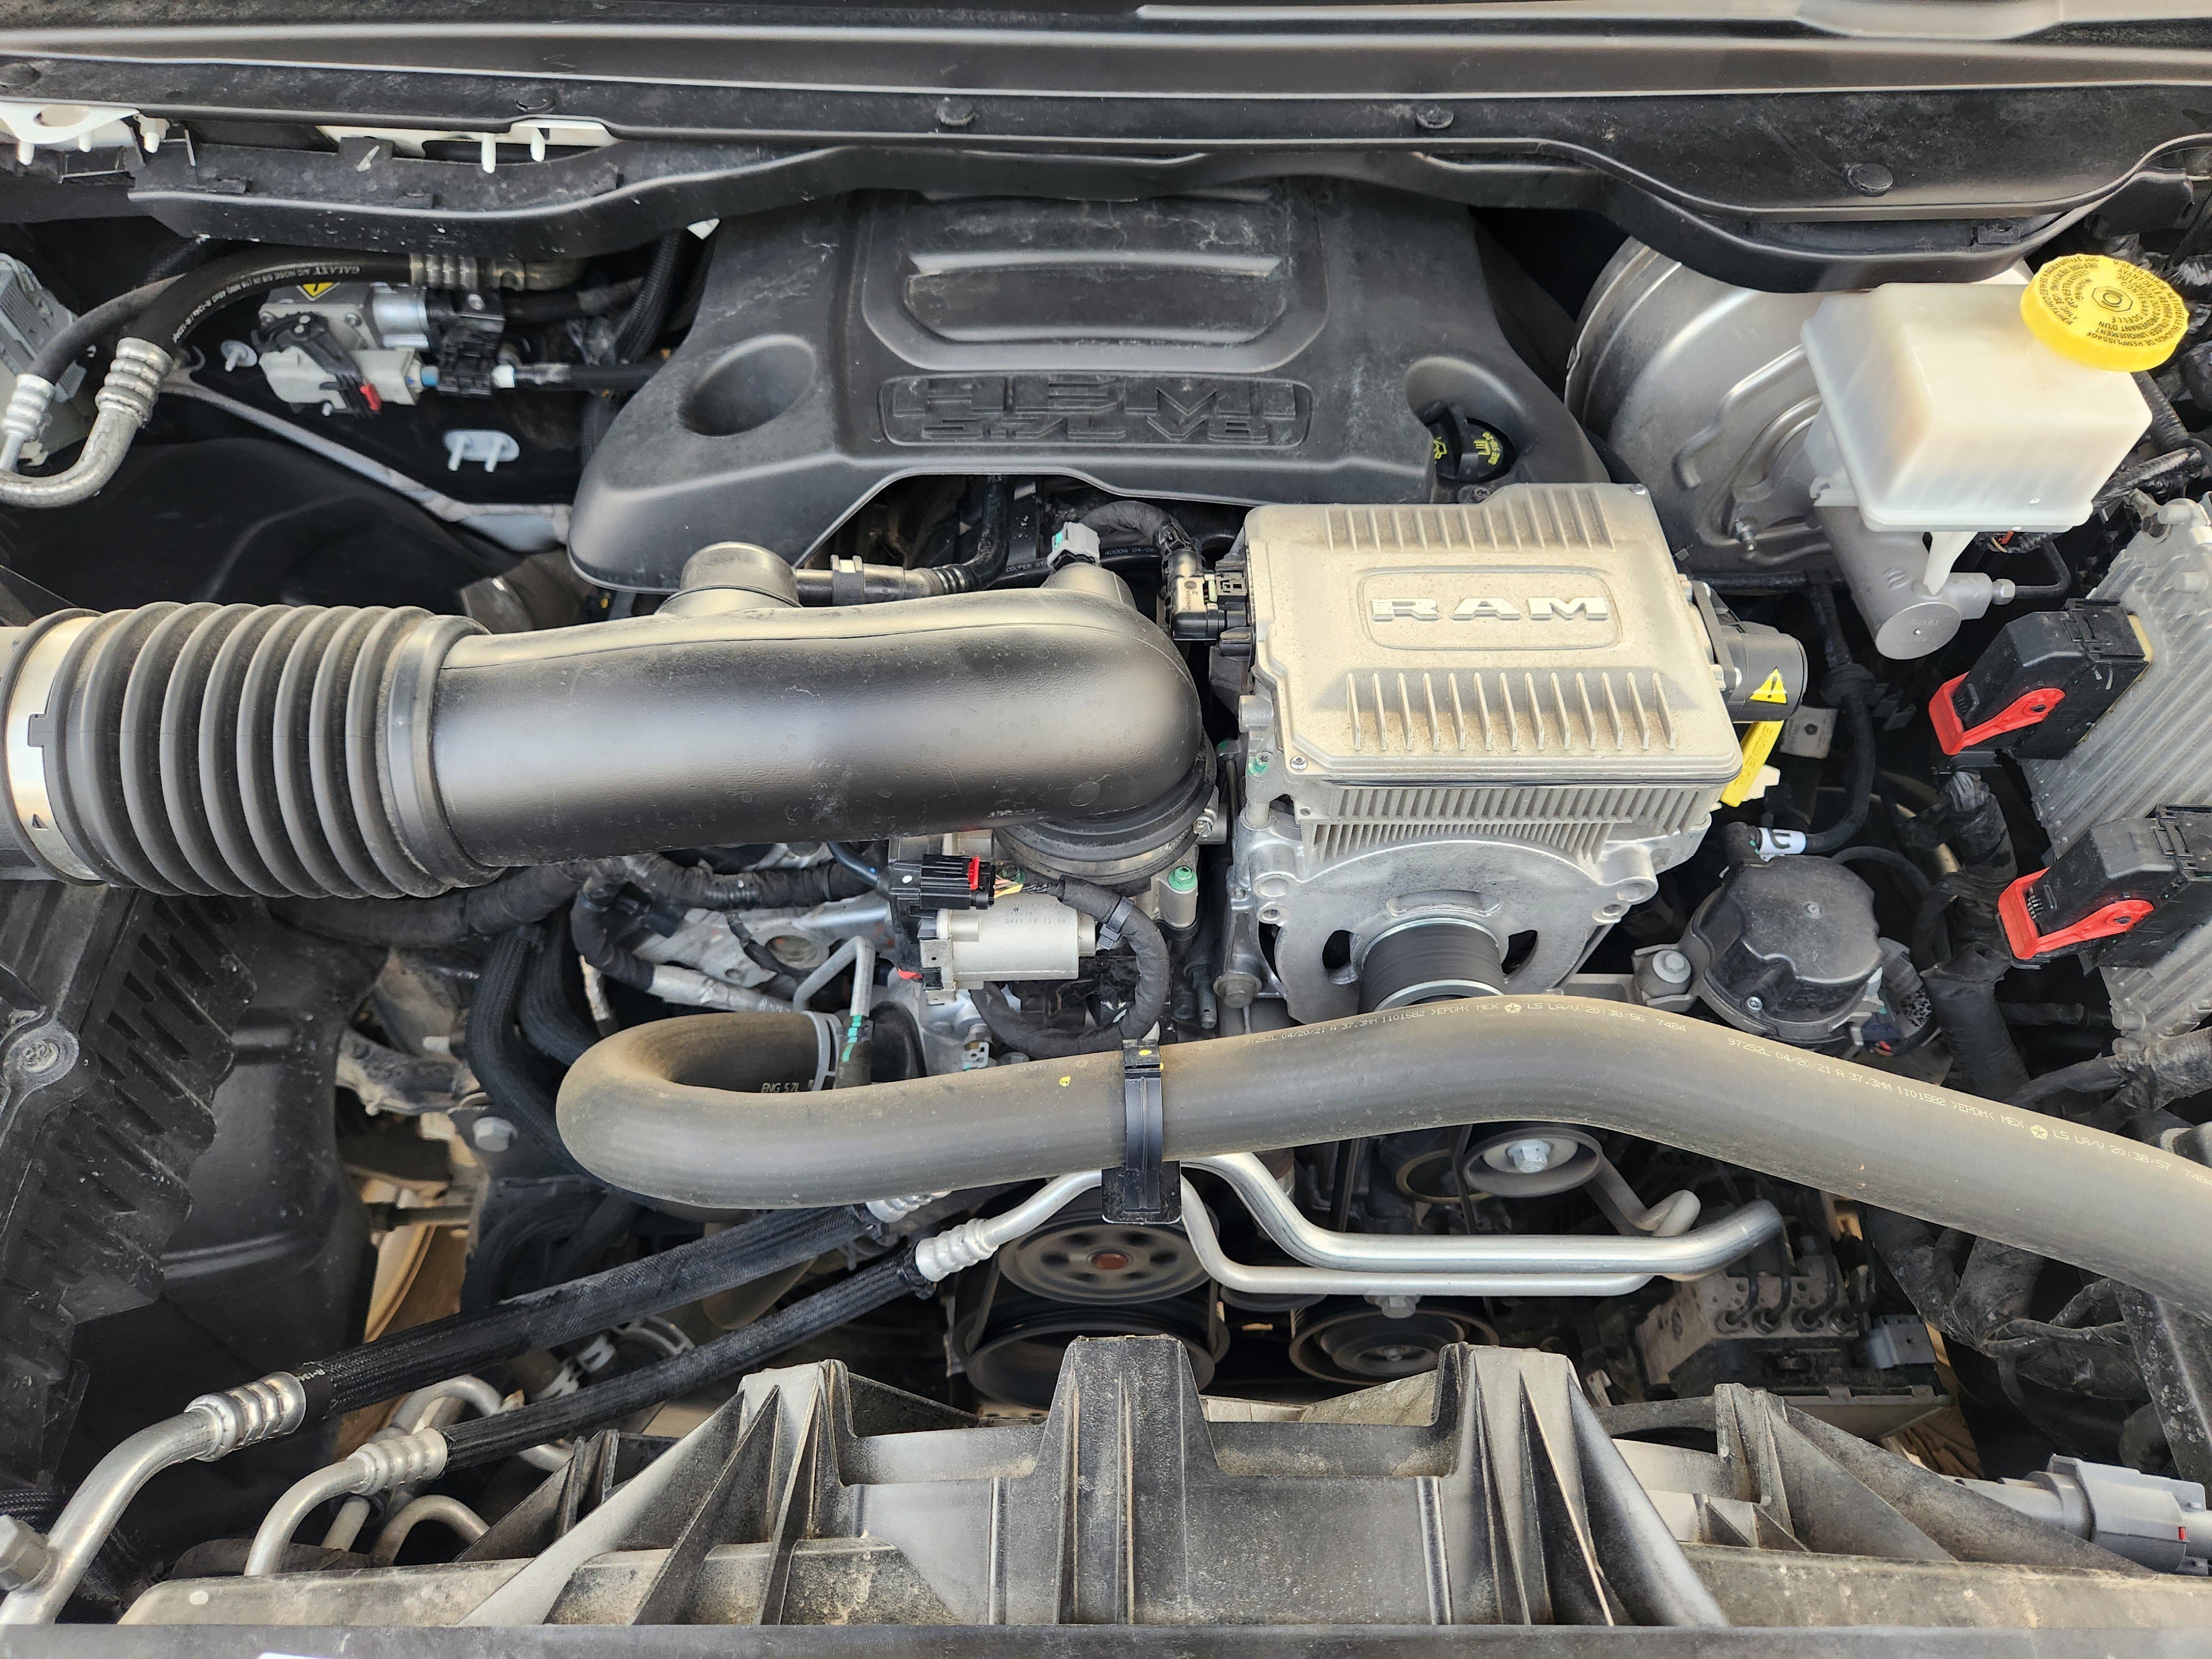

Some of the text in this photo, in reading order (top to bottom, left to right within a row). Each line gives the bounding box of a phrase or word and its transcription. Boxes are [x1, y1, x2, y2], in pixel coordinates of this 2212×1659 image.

[2086, 331, 2143, 347] REMPLISSAGE
[1371, 596, 1609, 622] RAM
[1281, 1027, 1326, 1039] 04/20/21
[1382, 1010, 1426, 1024] 1101582
[1477, 1003, 1499, 1011] MEX
[1585, 1005, 1646, 1023] 20:38:56
[1656, 1018, 1687, 1032] 7484
[1728, 1037, 1771, 1057] 97252L
[1776, 1051, 1832, 1074] 04/20/21
[1897, 1086, 1947, 1107] 1101582
[2000, 1114, 2025, 1129] MEX
[2110, 1144, 2173, 1171] 20:38:57
